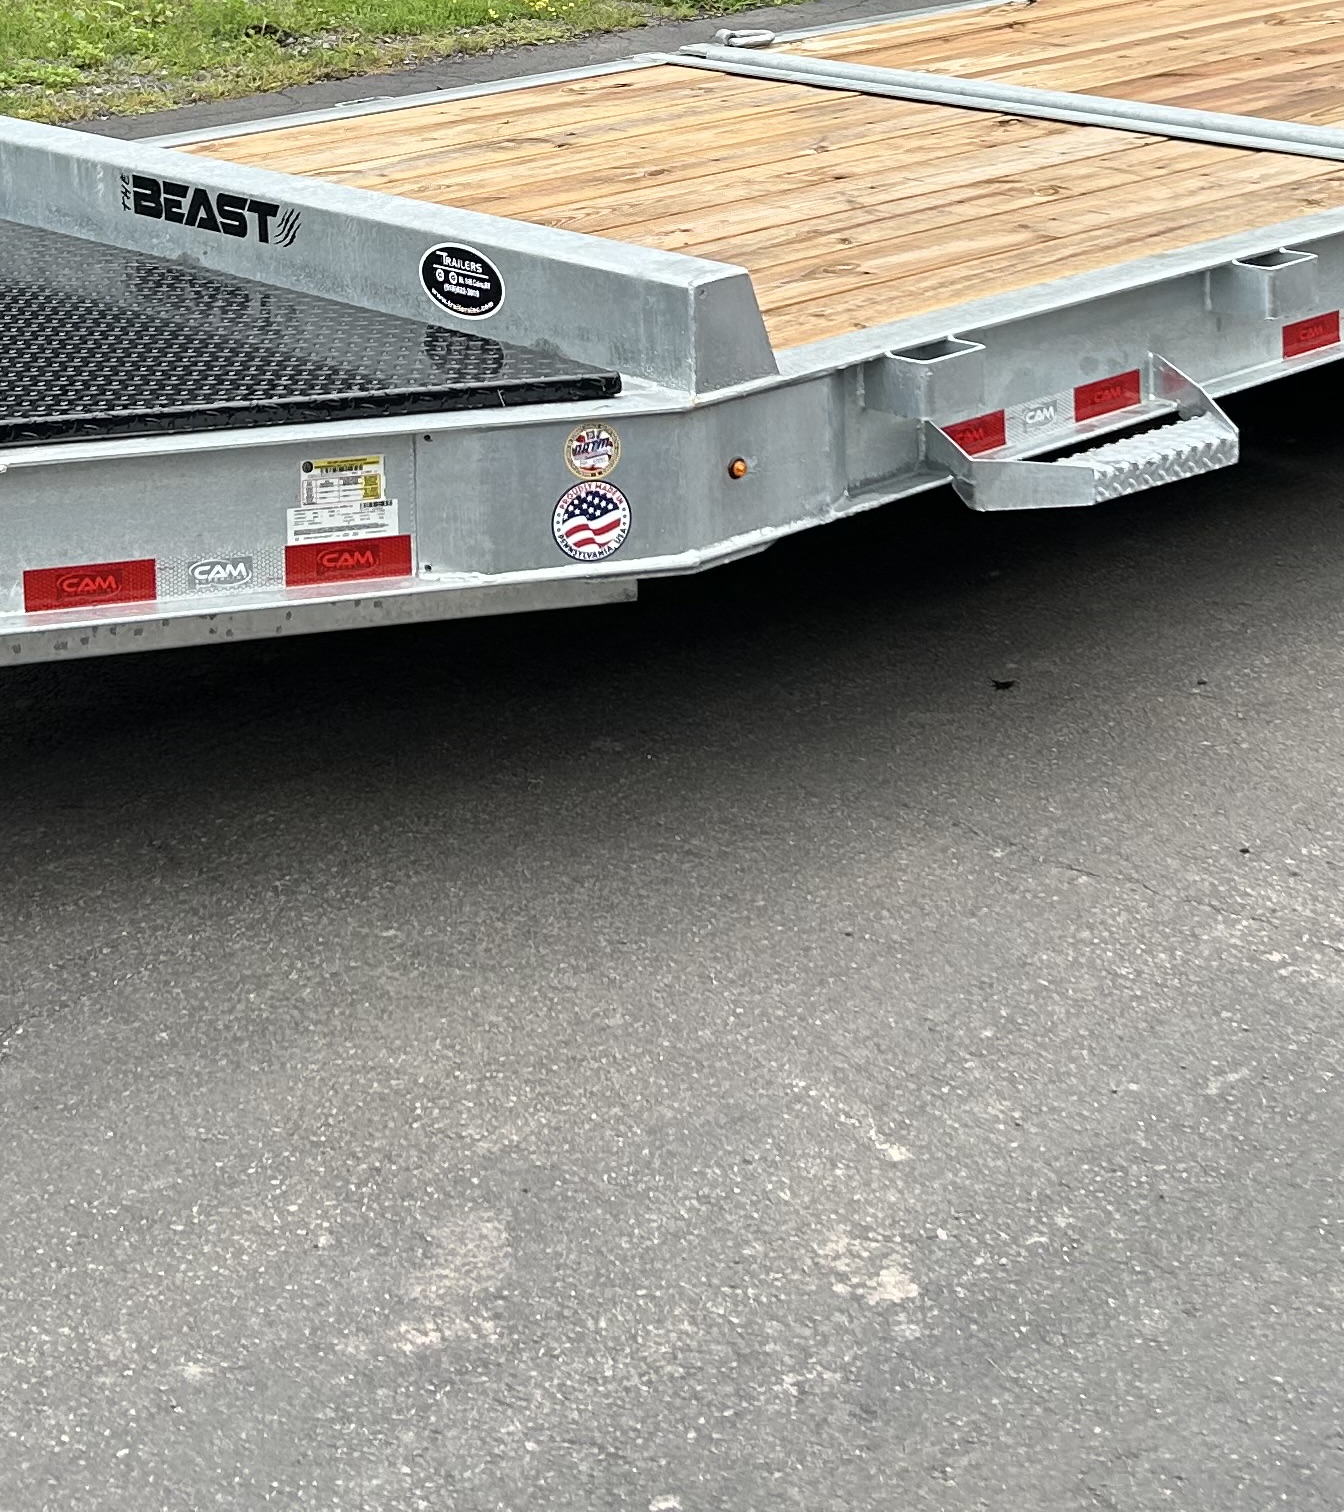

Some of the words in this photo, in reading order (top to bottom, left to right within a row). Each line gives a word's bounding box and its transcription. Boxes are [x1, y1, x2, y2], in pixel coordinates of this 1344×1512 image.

[132, 174, 280, 245] BEAST
[435, 250, 483, 274] TRAILERS
[1025, 405, 1055, 425] CAM
[559, 483, 593, 510] PROUDLY
[320, 549, 374, 569] CAM
[193, 562, 248, 581] CAM
[61, 574, 118, 596] CAM
